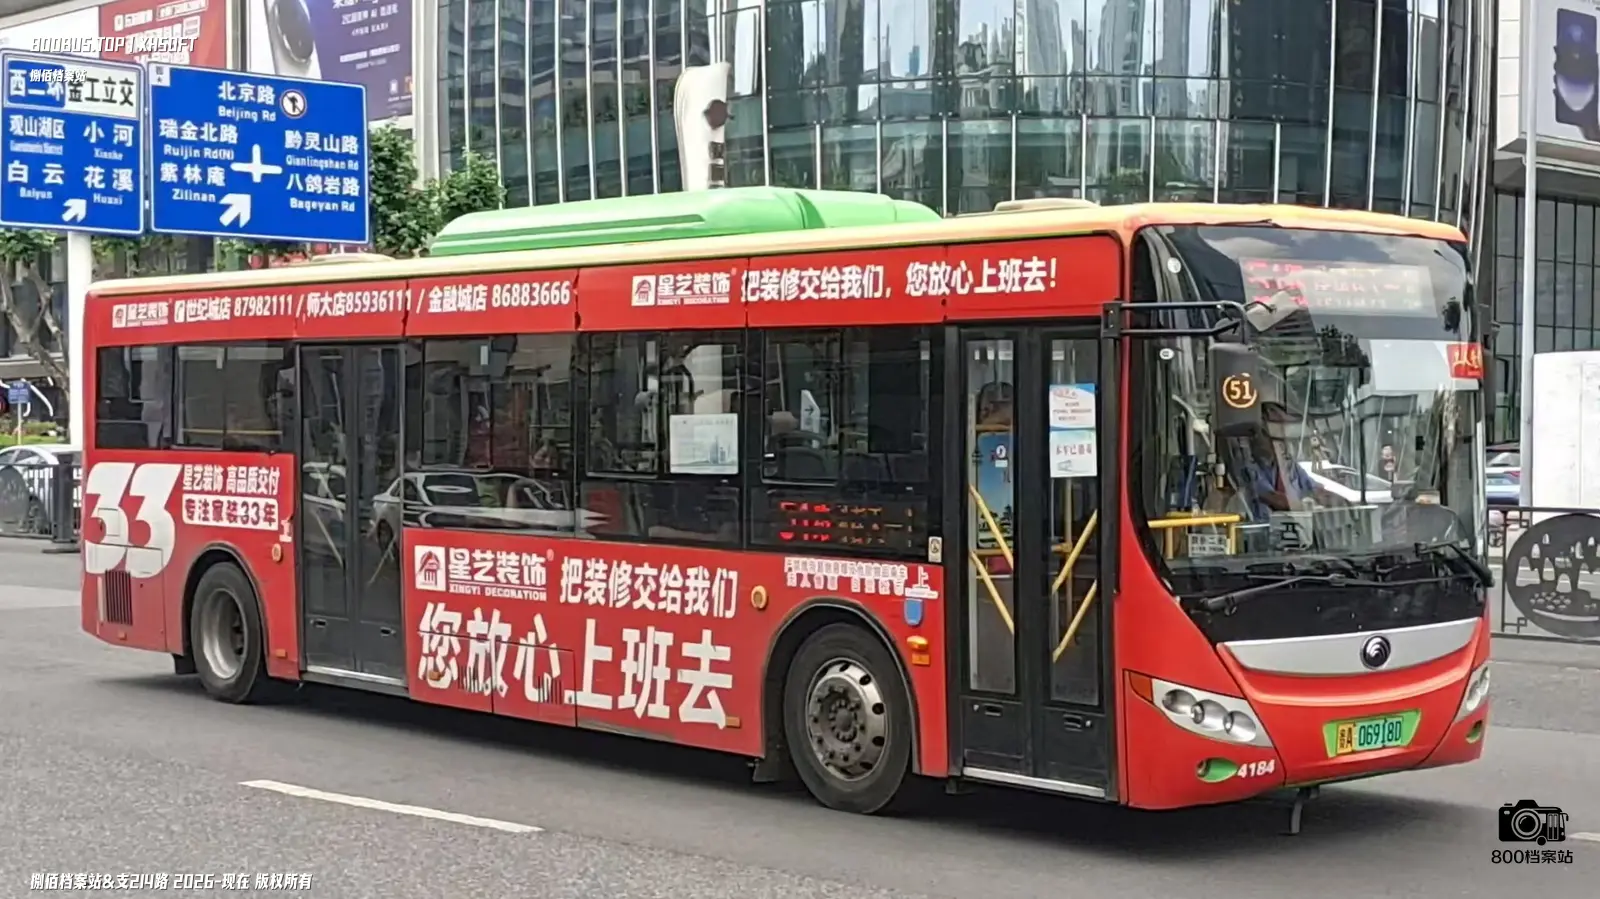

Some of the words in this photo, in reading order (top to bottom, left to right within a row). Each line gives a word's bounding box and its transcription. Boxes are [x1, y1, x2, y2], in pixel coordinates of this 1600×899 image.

[218, 81, 275, 105] 北京路
[218, 106, 257, 122] Beijing
[262, 111, 276, 122] Rd
[9, 115, 65, 139] 观山湖区
[83, 121, 134, 147] 小河
[159, 118, 238, 144] 瑞金北路
[164, 144, 199, 160] Ruijin
[285, 130, 359, 155] 黔灵山路
[8, 160, 64, 185] 白云
[160, 162, 225, 187] 紫林庵
[348, 160, 359, 171] Rd
[84, 166, 134, 192] 花溪
[286, 173, 360, 197] 八鸽岩路
[172, 188, 216, 202] Zilinan
[341, 200, 355, 212] Rd
[657, 272, 730, 296] 星艺装饰
[234, 294, 292, 317] 87982111
[428, 285, 488, 313] 金融城店
[492, 280, 571, 308] 86883666
[1230, 380, 1252, 400] 51
[183, 464, 224, 492] 星艺装饰
[226, 466, 280, 495] 高品质交付
[85, 461, 183, 579] 33
[184, 498, 276, 527] 专注家装33年
[448, 547, 546, 587] 星艺装饰
[449, 583, 481, 595] XINGYI
[485, 586, 547, 602] DECORATION
[560, 556, 738, 619] 把装修交给我们
[418, 602, 733, 730] 您放心上班去
[1237, 759, 1275, 779] 4184
